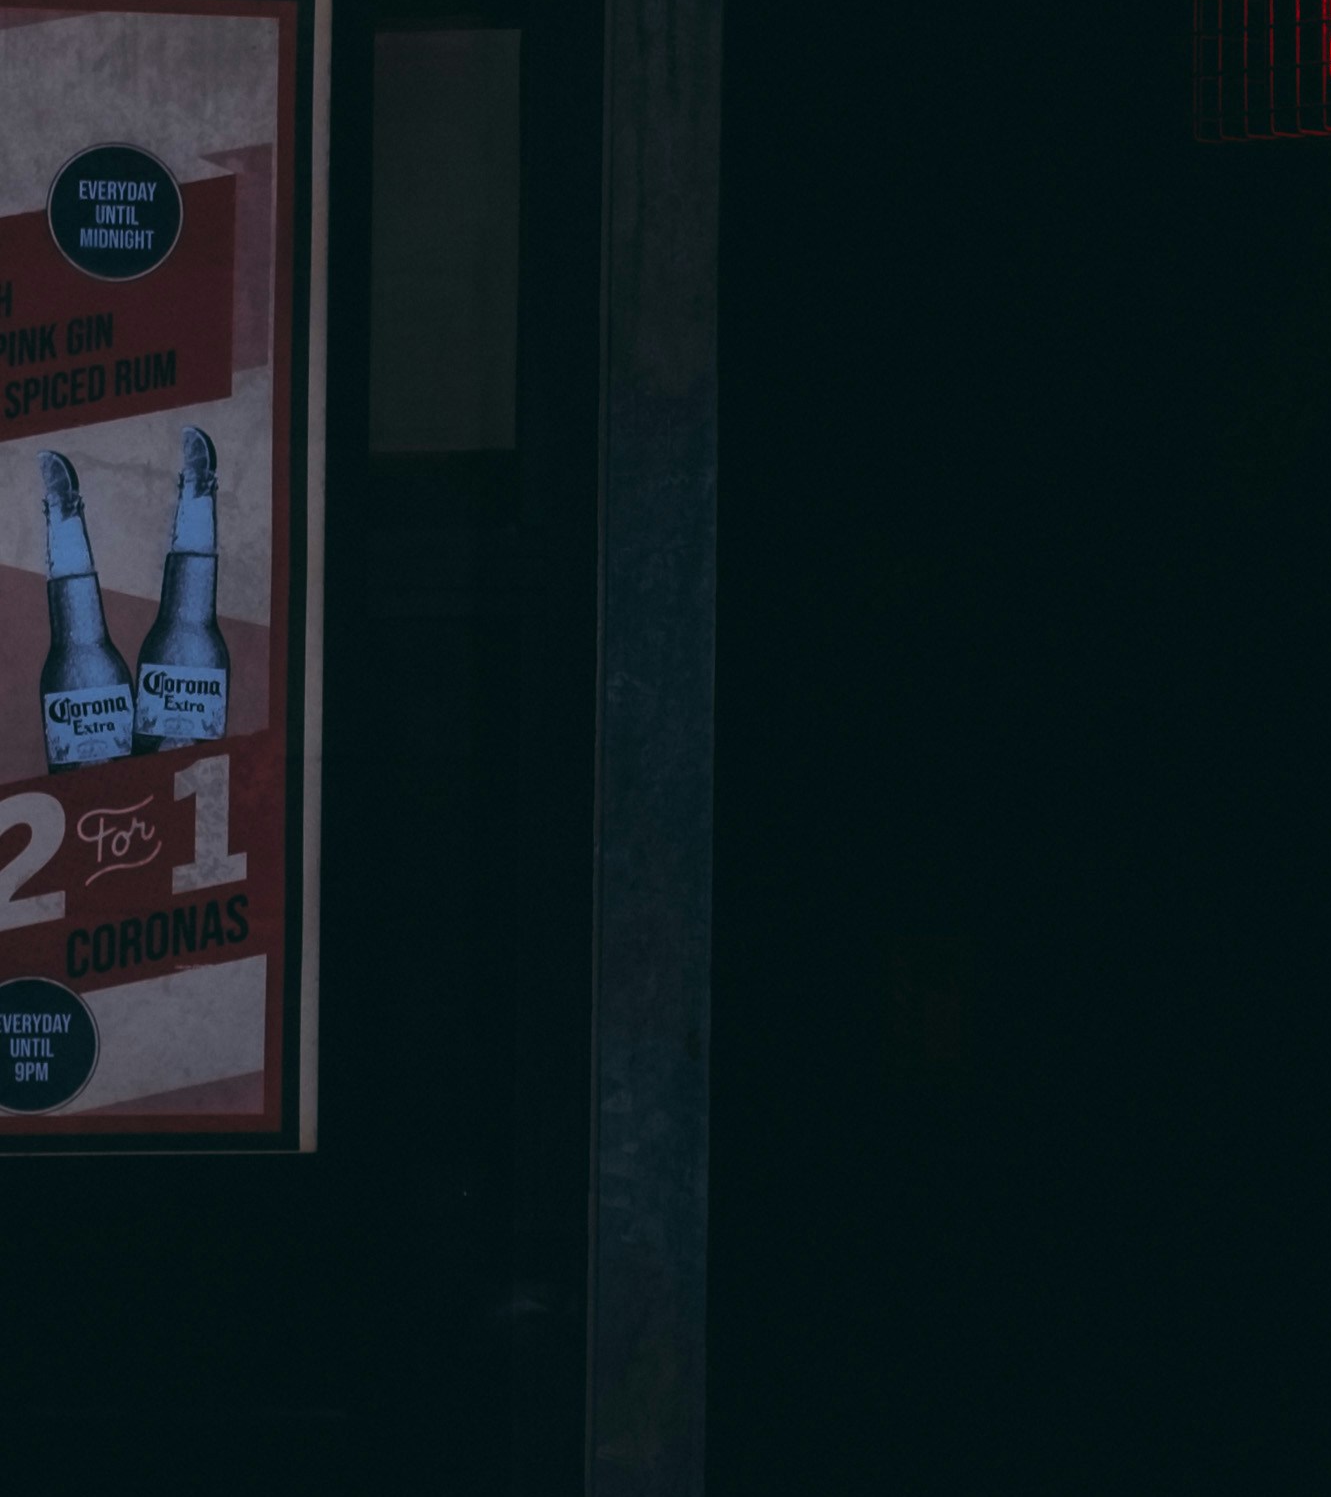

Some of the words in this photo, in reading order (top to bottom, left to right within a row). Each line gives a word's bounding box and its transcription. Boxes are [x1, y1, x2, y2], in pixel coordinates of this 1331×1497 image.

[79, 179, 157, 202] EVERYDAY
[95, 205, 139, 226] UNTIL
[79, 228, 154, 250] MIDNIGHT
[67, 312, 113, 356] GIN
[4, 364, 106, 419] SPICED
[115, 348, 176, 396] RUM
[143, 670, 221, 697] Corona
[49, 696, 129, 725] Corona
[164, 695, 204, 713] Extra
[73, 720, 115, 735] Extra
[0, 792, 66, 932] 2
[77, 795, 162, 879] For
[172, 754, 247, 894] 1
[66, 894, 249, 979] CORONAS
[10, 1037, 55, 1058] UNTIL
[14, 1061, 49, 1082] 9PM
